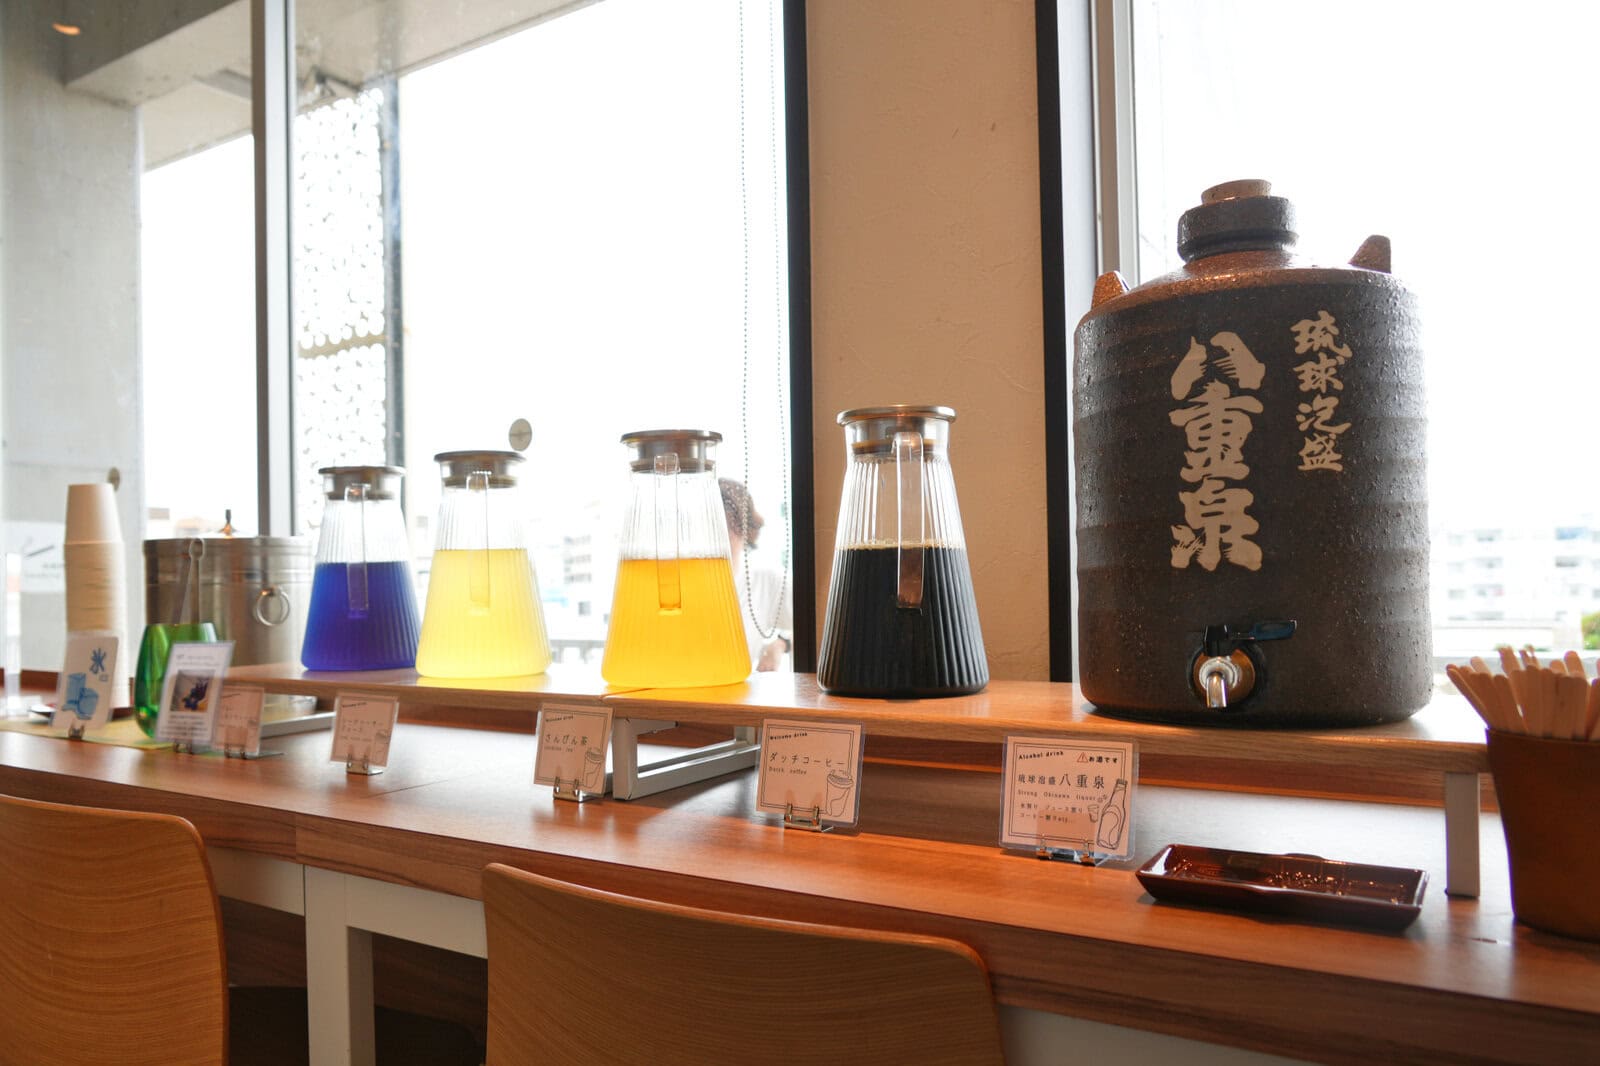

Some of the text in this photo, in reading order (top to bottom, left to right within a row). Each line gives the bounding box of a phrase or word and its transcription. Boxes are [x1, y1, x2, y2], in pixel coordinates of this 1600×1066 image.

[1290, 310, 1352, 472] 琉球泡盛
[1169, 331, 1266, 571] 八重泉
[769, 752, 845, 768] ダッチコーヒー
[1088, 756, 1118, 764] お酒です
